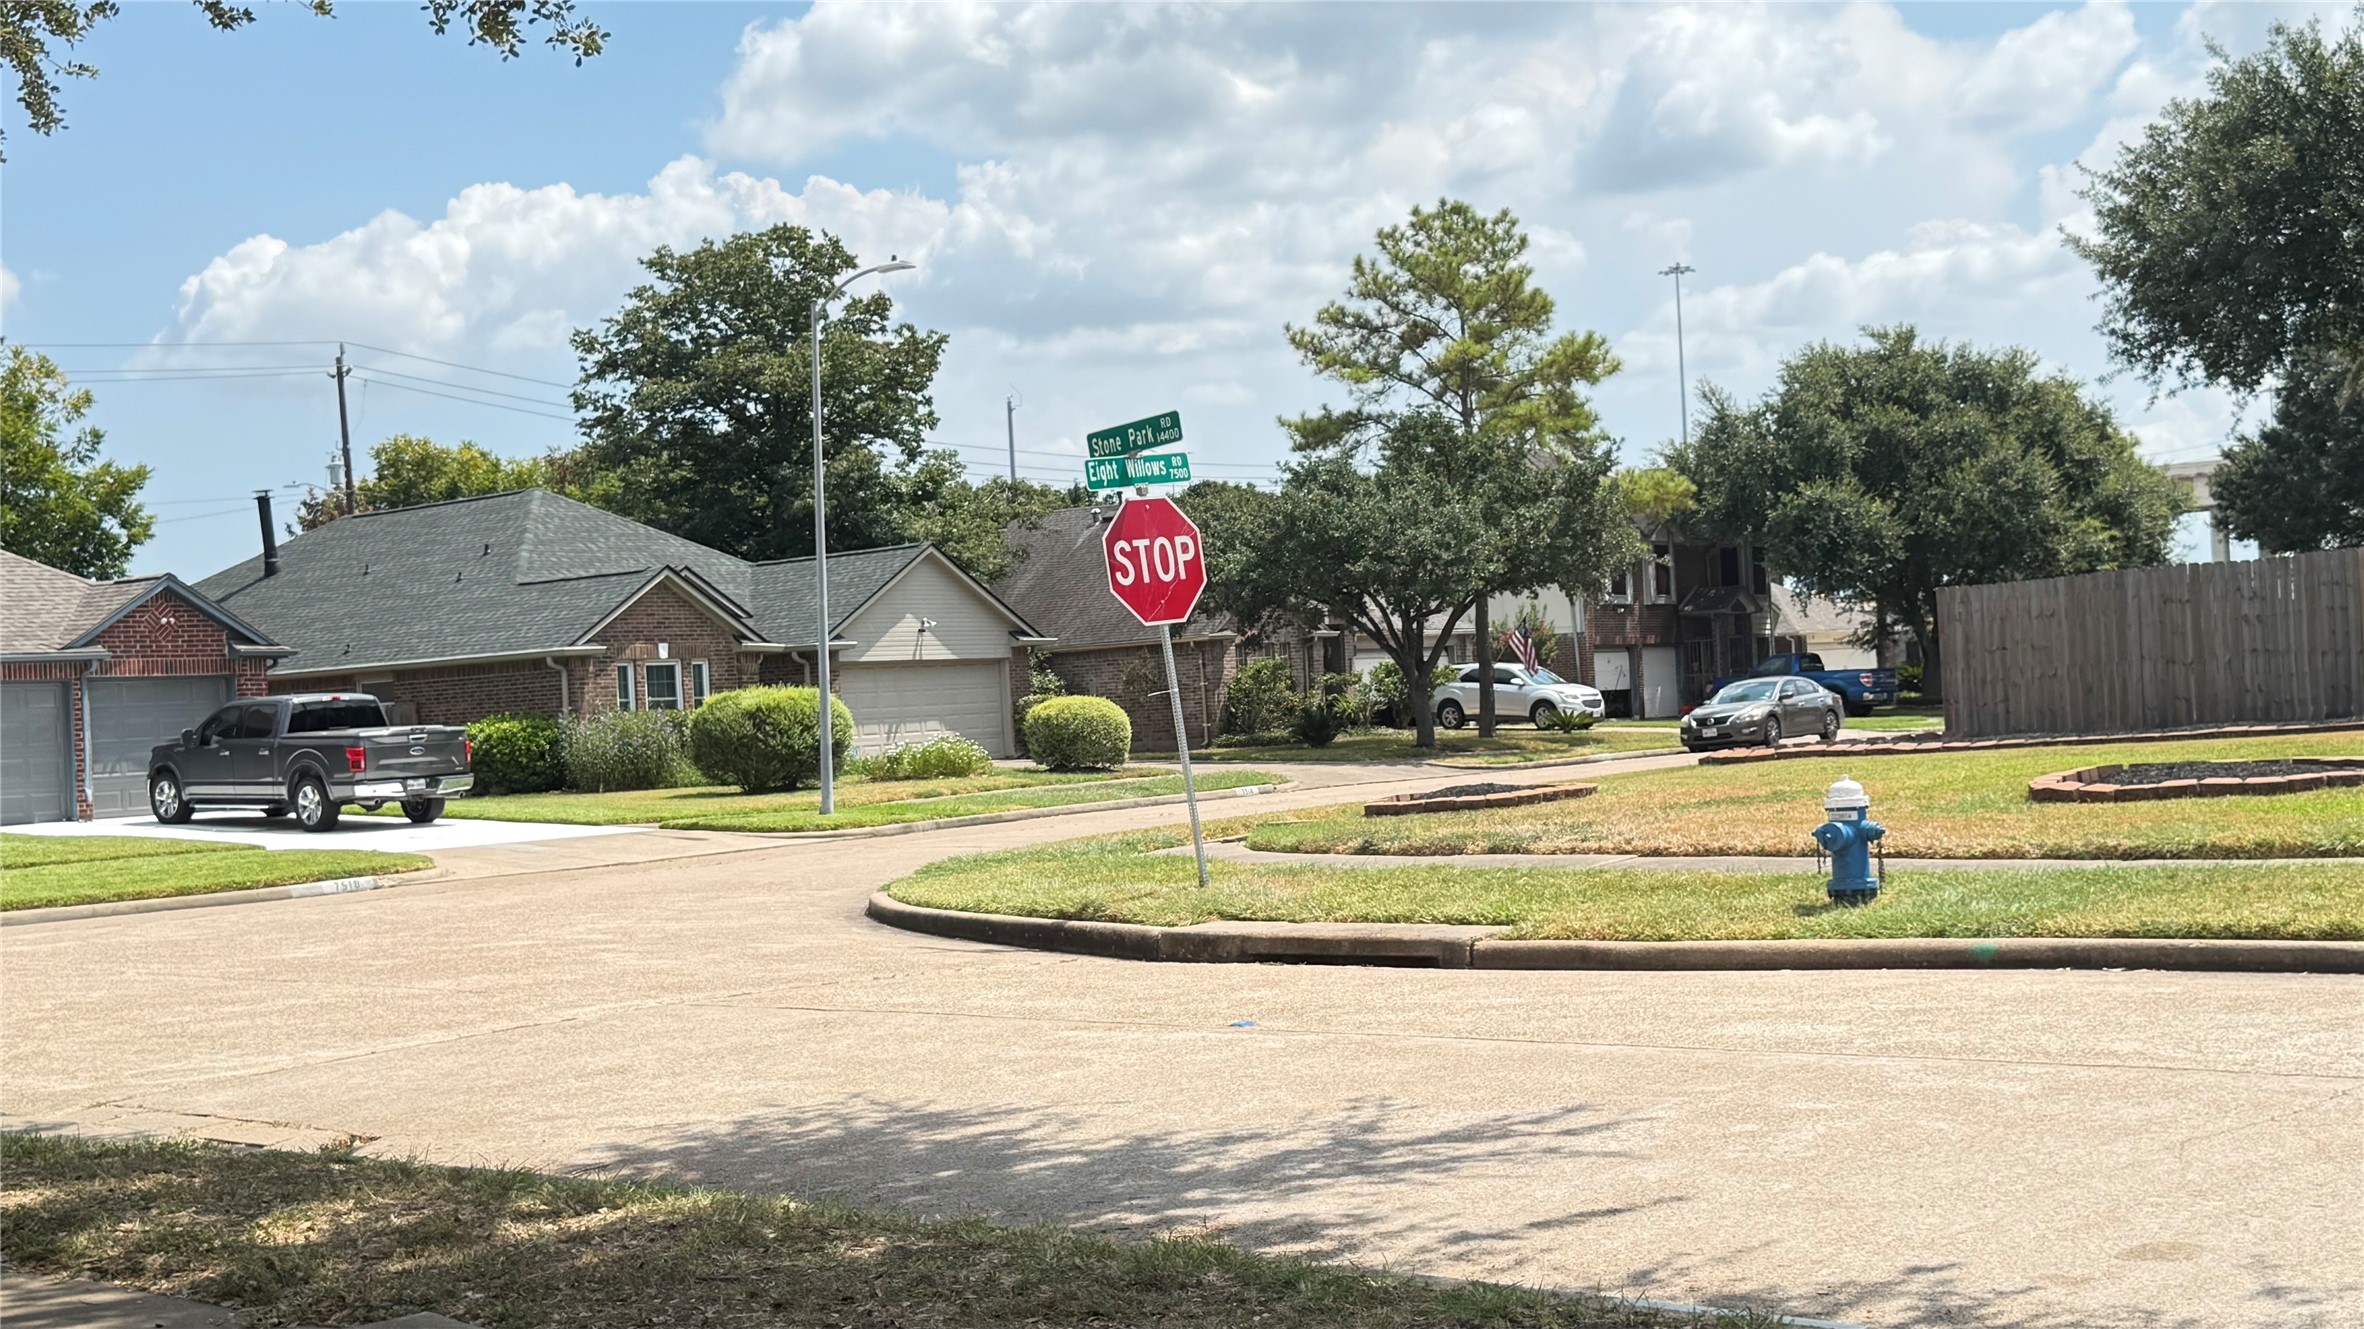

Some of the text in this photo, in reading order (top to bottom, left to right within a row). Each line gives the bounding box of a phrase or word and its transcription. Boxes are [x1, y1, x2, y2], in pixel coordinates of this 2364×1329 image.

[1160, 417, 1171, 428] RD
[1092, 424, 1154, 457] Stone Park
[1156, 428, 1179, 442] 14400
[1088, 456, 1182, 486] Eight Willows RD
[1169, 468, 1188, 480] 7500
[1113, 535, 1195, 586] STOP
